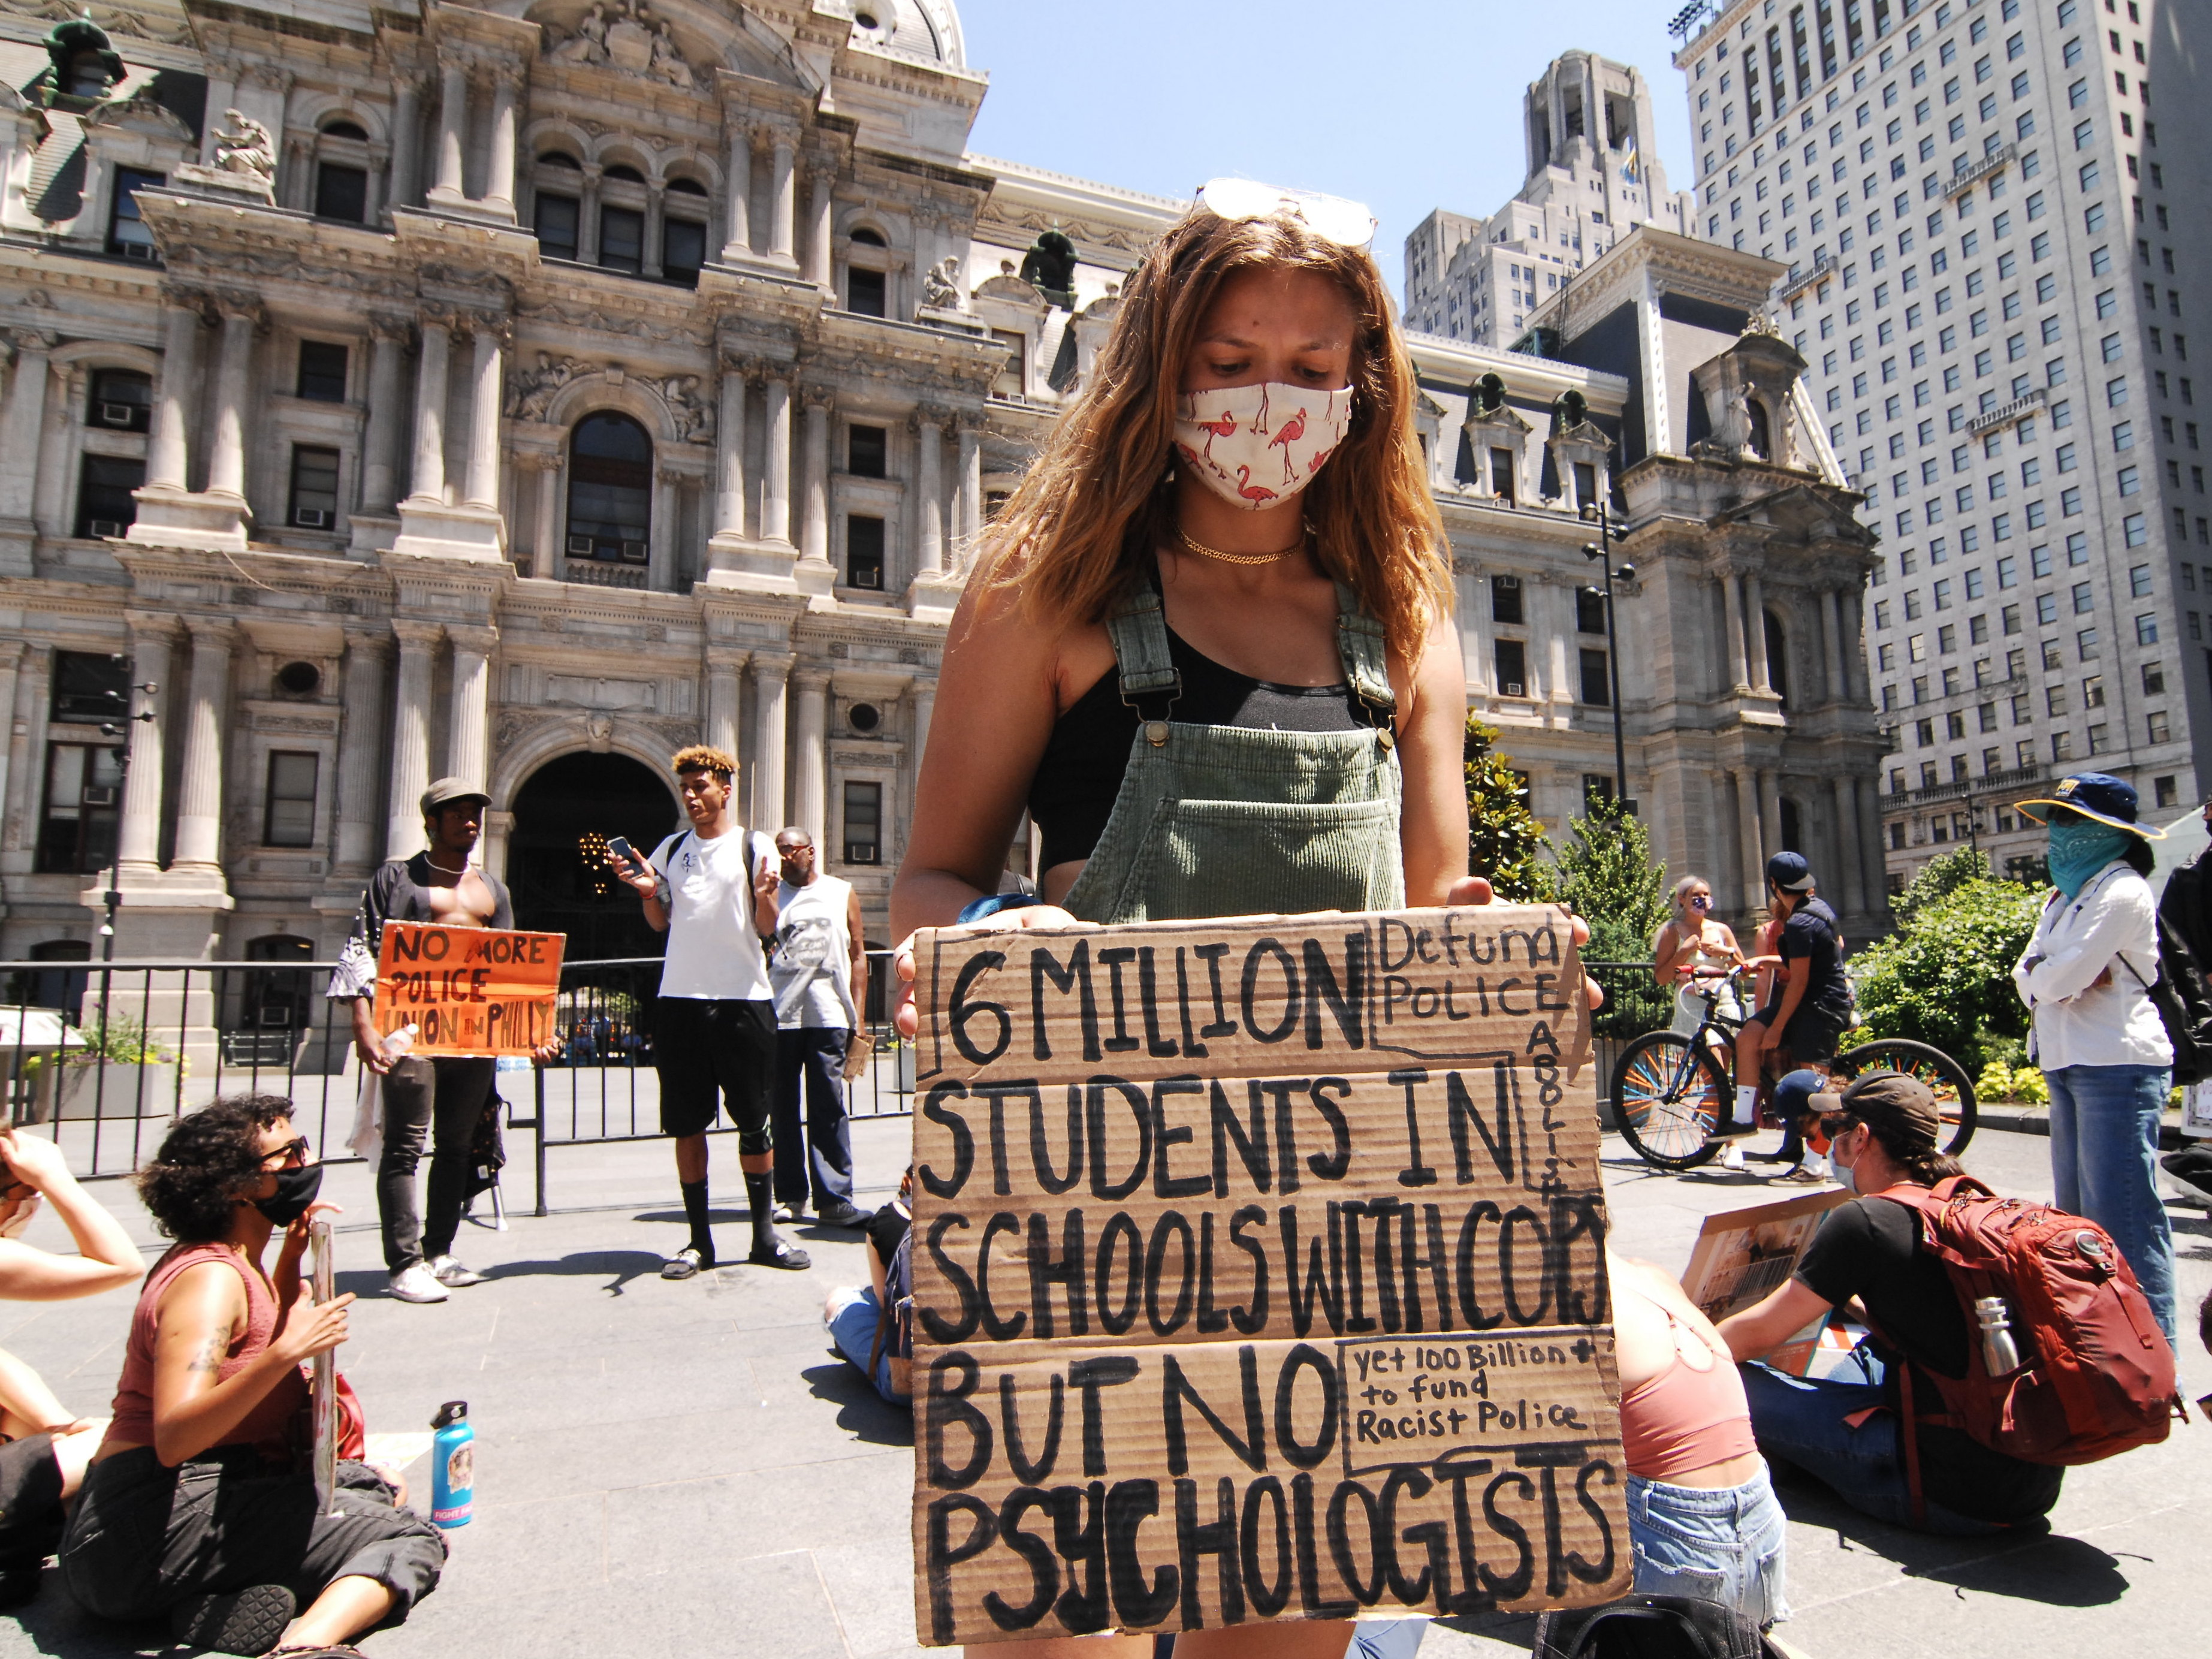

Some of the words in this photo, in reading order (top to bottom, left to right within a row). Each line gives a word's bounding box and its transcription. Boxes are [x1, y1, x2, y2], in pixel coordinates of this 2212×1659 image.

[393, 930, 450, 963] NO
[464, 936, 548, 964] MORE
[1379, 910, 1558, 972] Defund
[391, 968, 491, 1006] POLICE
[949, 949, 1012, 1065] 6
[1031, 932, 1369, 1063] MILLION
[464, 1016, 484, 1035] IN
[487, 1001, 550, 1049] PHILLY
[918, 1074, 1352, 1200] STUDENTS
[1387, 1058, 1516, 1187] IN
[1526, 1020, 1568, 1206] ABOLISH
[918, 1202, 1269, 1344] SCHOOLS
[1276, 1198, 1454, 1339] WITH
[1416, 1346, 1460, 1371] 100
[1466, 1340, 1566, 1371] Billion
[1360, 1384, 1398, 1406] to
[1408, 1368, 1489, 1403] fund
[927, 1350, 1142, 1491] BUT
[1163, 1343, 1340, 1477] NO
[1357, 1407, 1468, 1444] Racist
[1478, 1398, 1588, 1433] Police
[435, 1509, 459, 1519] FIGHT
[927, 1443, 1617, 1646] PSYCHOLOGISTS
